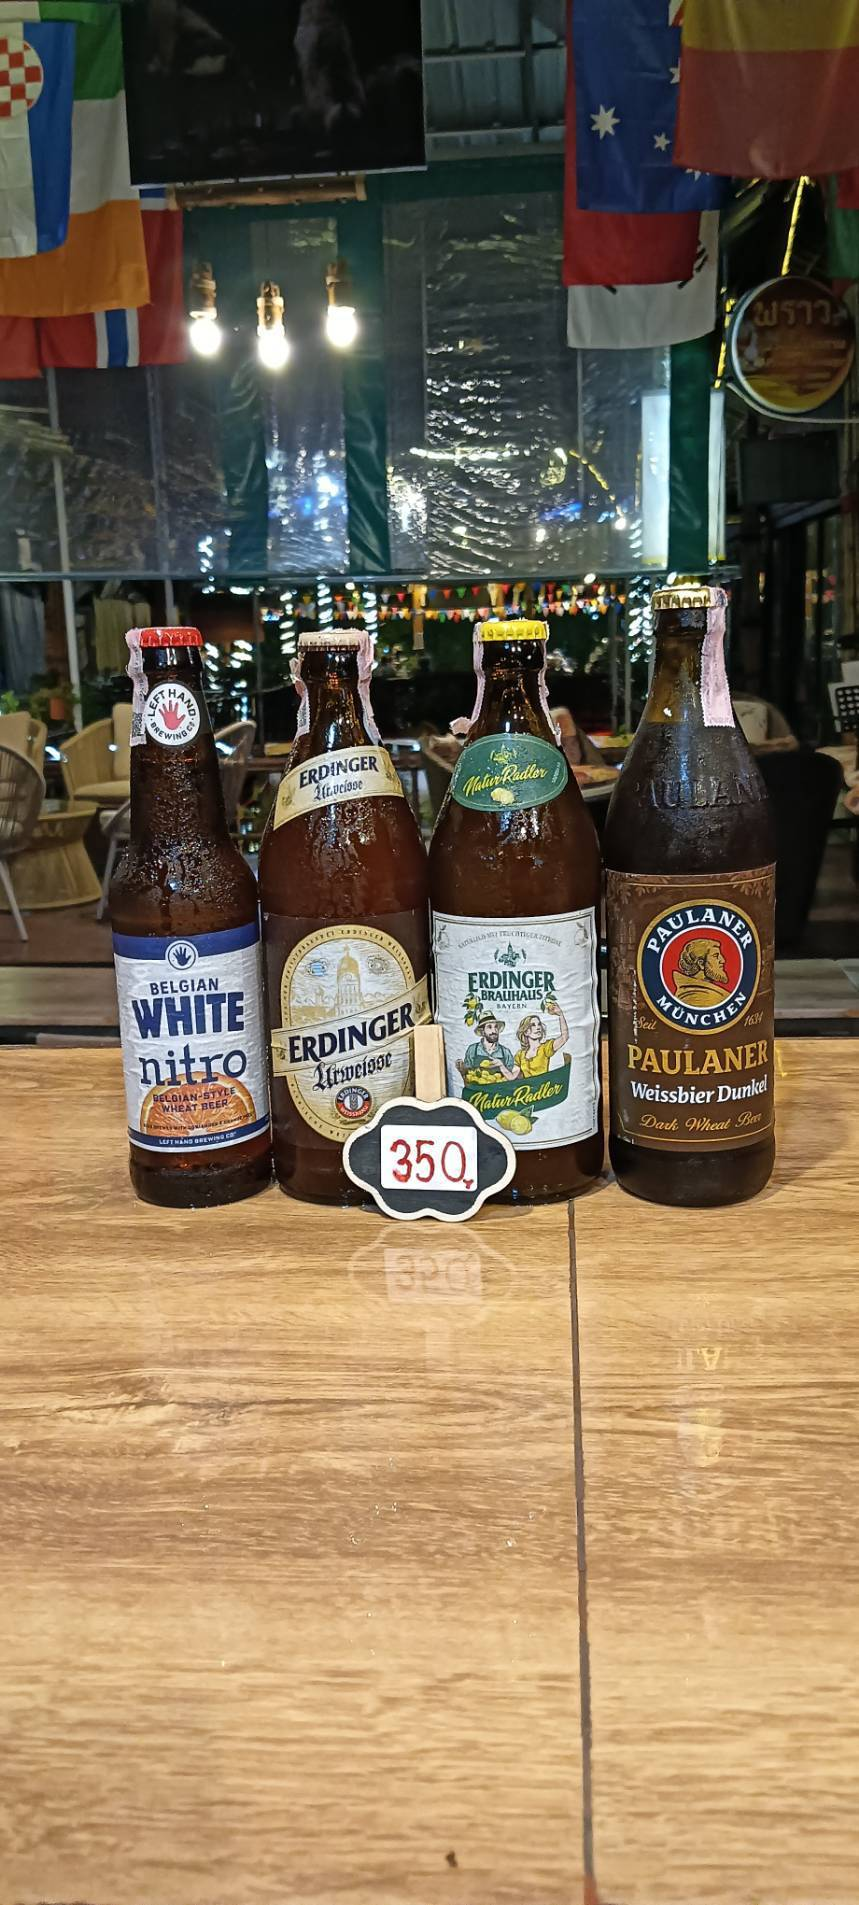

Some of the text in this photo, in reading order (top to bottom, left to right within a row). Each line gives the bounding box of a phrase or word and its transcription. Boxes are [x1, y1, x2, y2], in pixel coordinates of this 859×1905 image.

[148, 689, 196, 716] LEFT HAND
[151, 722, 187, 740] BREWING
[299, 756, 379, 789] ERDINGER
[647, 908, 752, 953] PAULANER
[150, 978, 219, 995] BELGIAN
[467, 970, 556, 992] ERDINGER
[481, 989, 543, 1002] BRAUHAUS
[132, 991, 245, 1039] WHITE
[657, 992, 746, 1025] MÜNCHEN
[288, 1002, 415, 1064] ERDINGER
[139, 1043, 247, 1087] nitro
[312, 1052, 392, 1092] Urweisse
[627, 1039, 769, 1075] PAULANER
[152, 1086, 236, 1103] BELGIAN-STYLE
[630, 1074, 768, 1104] Weissbier Dunkel
[161, 1099, 228, 1113] WHEAT BEER
[640, 1114, 679, 1131] Dark
[685, 1117, 731, 1131] Wheat
